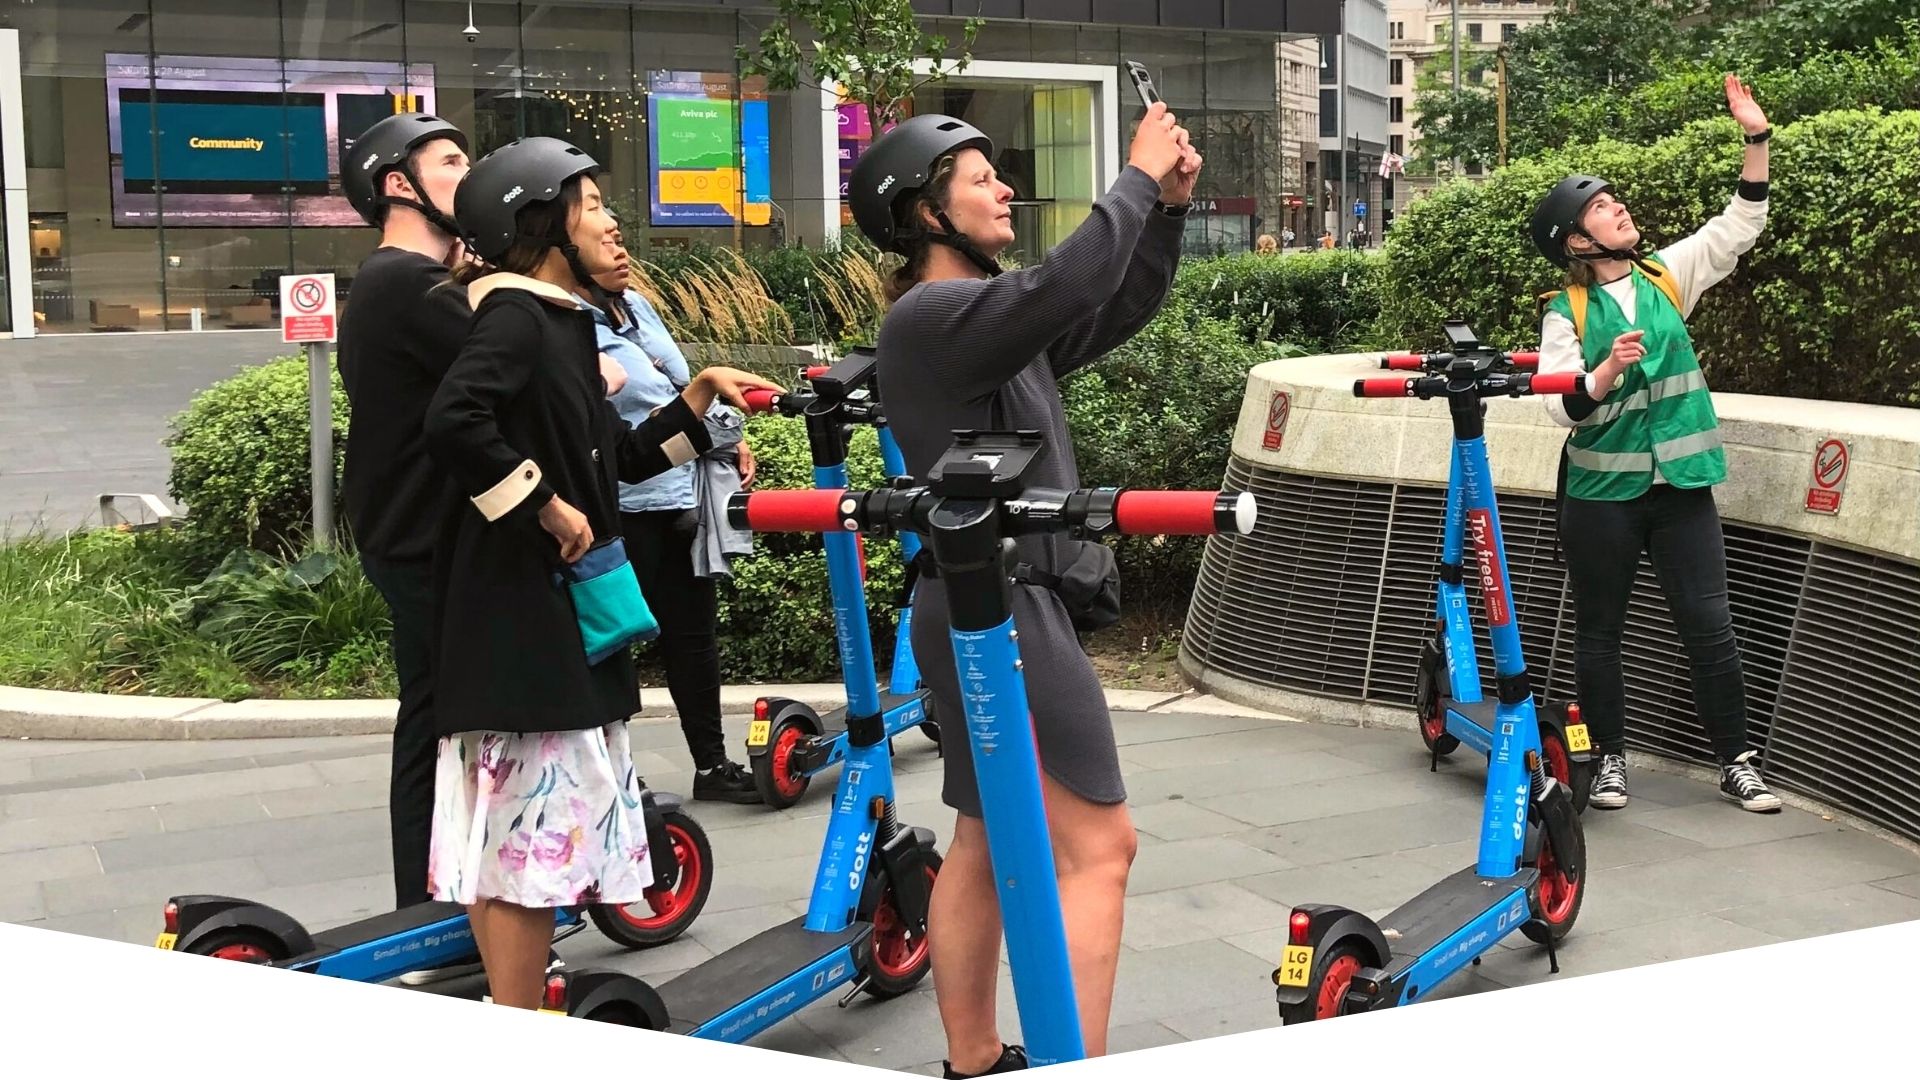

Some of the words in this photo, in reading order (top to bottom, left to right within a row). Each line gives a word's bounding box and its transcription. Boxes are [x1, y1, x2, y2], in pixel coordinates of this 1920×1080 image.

[175, 67, 206, 79] August
[680, 109, 704, 118] Aviva
[705, 110, 718, 119] plc
[189, 137, 264, 152] Community
[877, 175, 896, 194] dott
[503, 185, 524, 203] dott
[1471, 515, 1487, 545] Try
[1478, 550, 1499, 591] free!
[1445, 636, 1456, 675] dott
[1571, 728, 1583, 737] LP
[1574, 739, 1587, 748] 69
[1512, 784, 1527, 840] dott
[849, 831, 871, 890] dott
[373, 945, 400, 960] Small
[424, 936, 440, 946] Big
[441, 928, 471, 942] chang
[1288, 951, 1308, 964] LG
[1287, 968, 1303, 980] 14
[756, 1006, 769, 1018] Big
